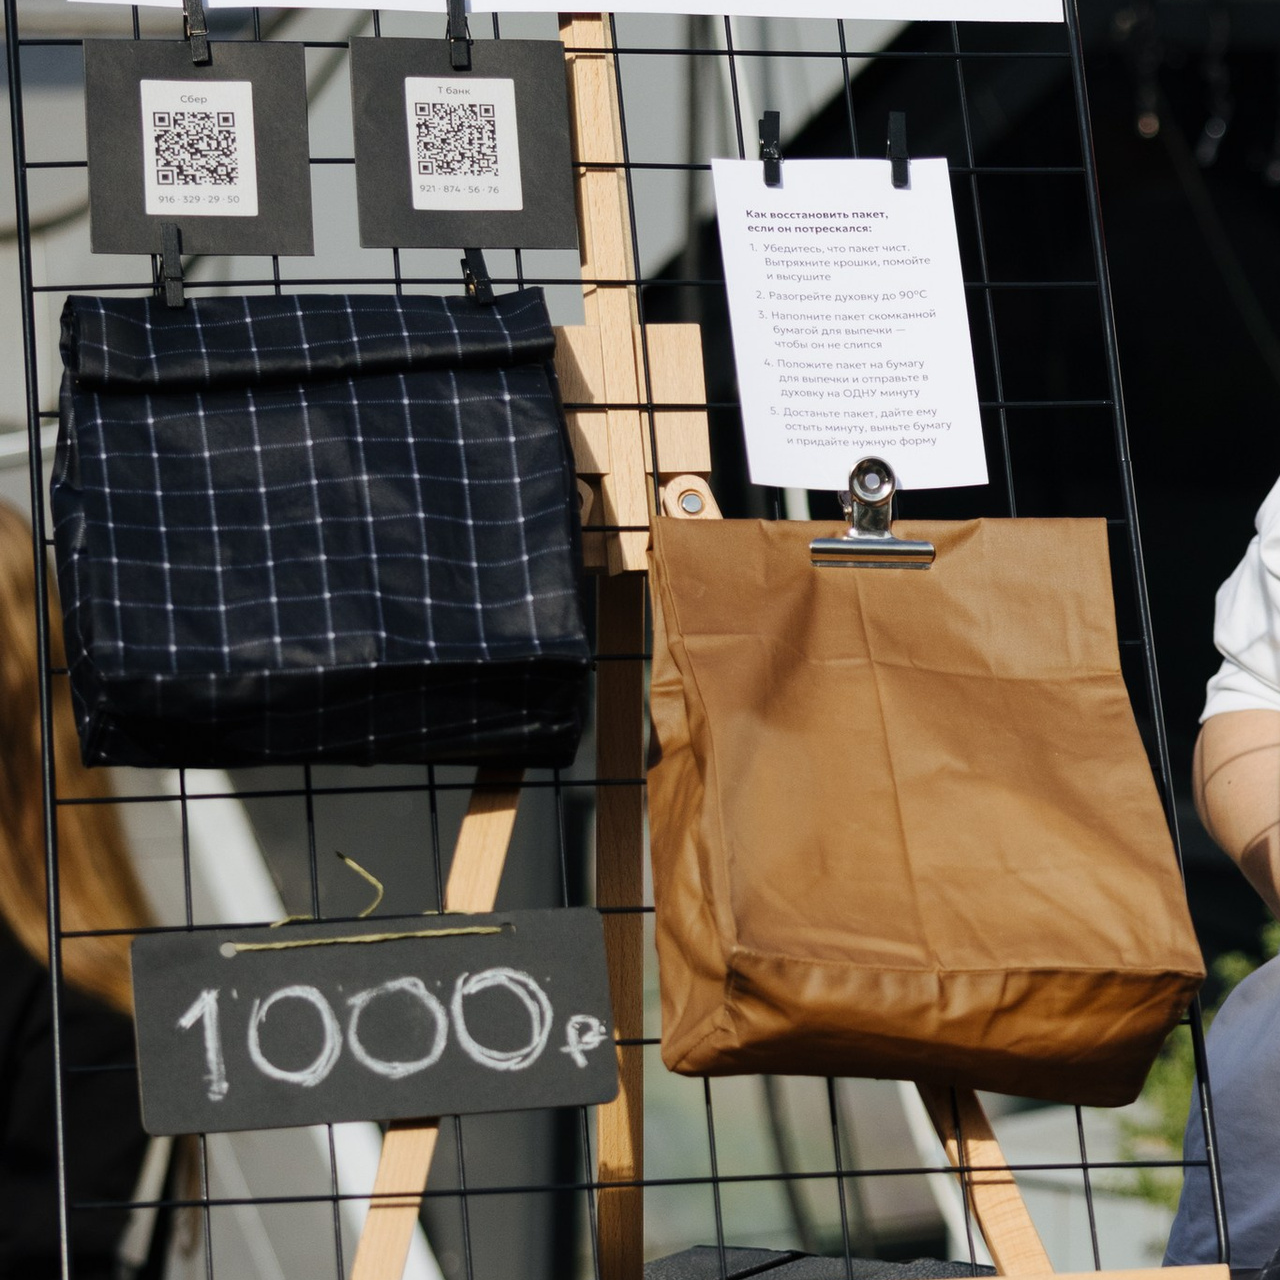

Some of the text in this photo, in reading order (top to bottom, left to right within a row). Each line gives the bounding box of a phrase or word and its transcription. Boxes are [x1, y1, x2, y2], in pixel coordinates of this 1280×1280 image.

[437, 86, 471, 95] Т банк
[180, 94, 208, 105] Сбер
[419, 184, 436, 193] 921
[443, 184, 461, 193] 874
[468, 185, 481, 194] 56
[487, 185, 500, 194] 76
[158, 195, 175, 204] 916
[183, 195, 201, 204] 329
[208, 195, 220, 204] 29
[227, 195, 240, 204] 50
[746, 209, 889, 219] Как восстановить пакет,
[747, 224, 872, 234] если он потрескался:
[762, 244, 825, 254] Убедитесь,
[827, 245, 847, 253] что
[848, 244, 880, 253] пакет
[882, 244, 910, 252] чист.
[764, 256, 931, 268] Вытряхните крошки, помойте
[766, 273, 832, 283] и высушите
[769, 291, 832, 302] Разогрейте
[834, 292, 879, 302] духовку
[881, 292, 897, 301] до
[771, 311, 832, 321] Наполните
[835, 312, 866, 321] пакет
[868, 308, 937, 320] скомканной
[772, 324, 819, 336] бумагой
[821, 326, 843, 336] для
[845, 326, 893, 335] выпечки
[774, 340, 882, 349] чтобы он не слипся
[777, 359, 834, 370] Положите
[836, 361, 867, 369] пакет
[870, 360, 884, 368] на
[886, 359, 925, 370] бумагу
[779, 374, 800, 384] для
[802, 375, 850, 384] выпечки
[852, 375, 859, 383] и
[862, 374, 920, 385] отправьте
[780, 388, 920, 399] духовку на ОДНУ минуту
[783, 407, 841, 418] Достаньте
[843, 409, 878, 419] пакет,
[880, 408, 914, 418] дайте
[916, 408, 938, 418] ему
[785, 421, 952, 434] остыть минуту, выньте бумагу
[787, 437, 937, 447] и придайте нужную форму
